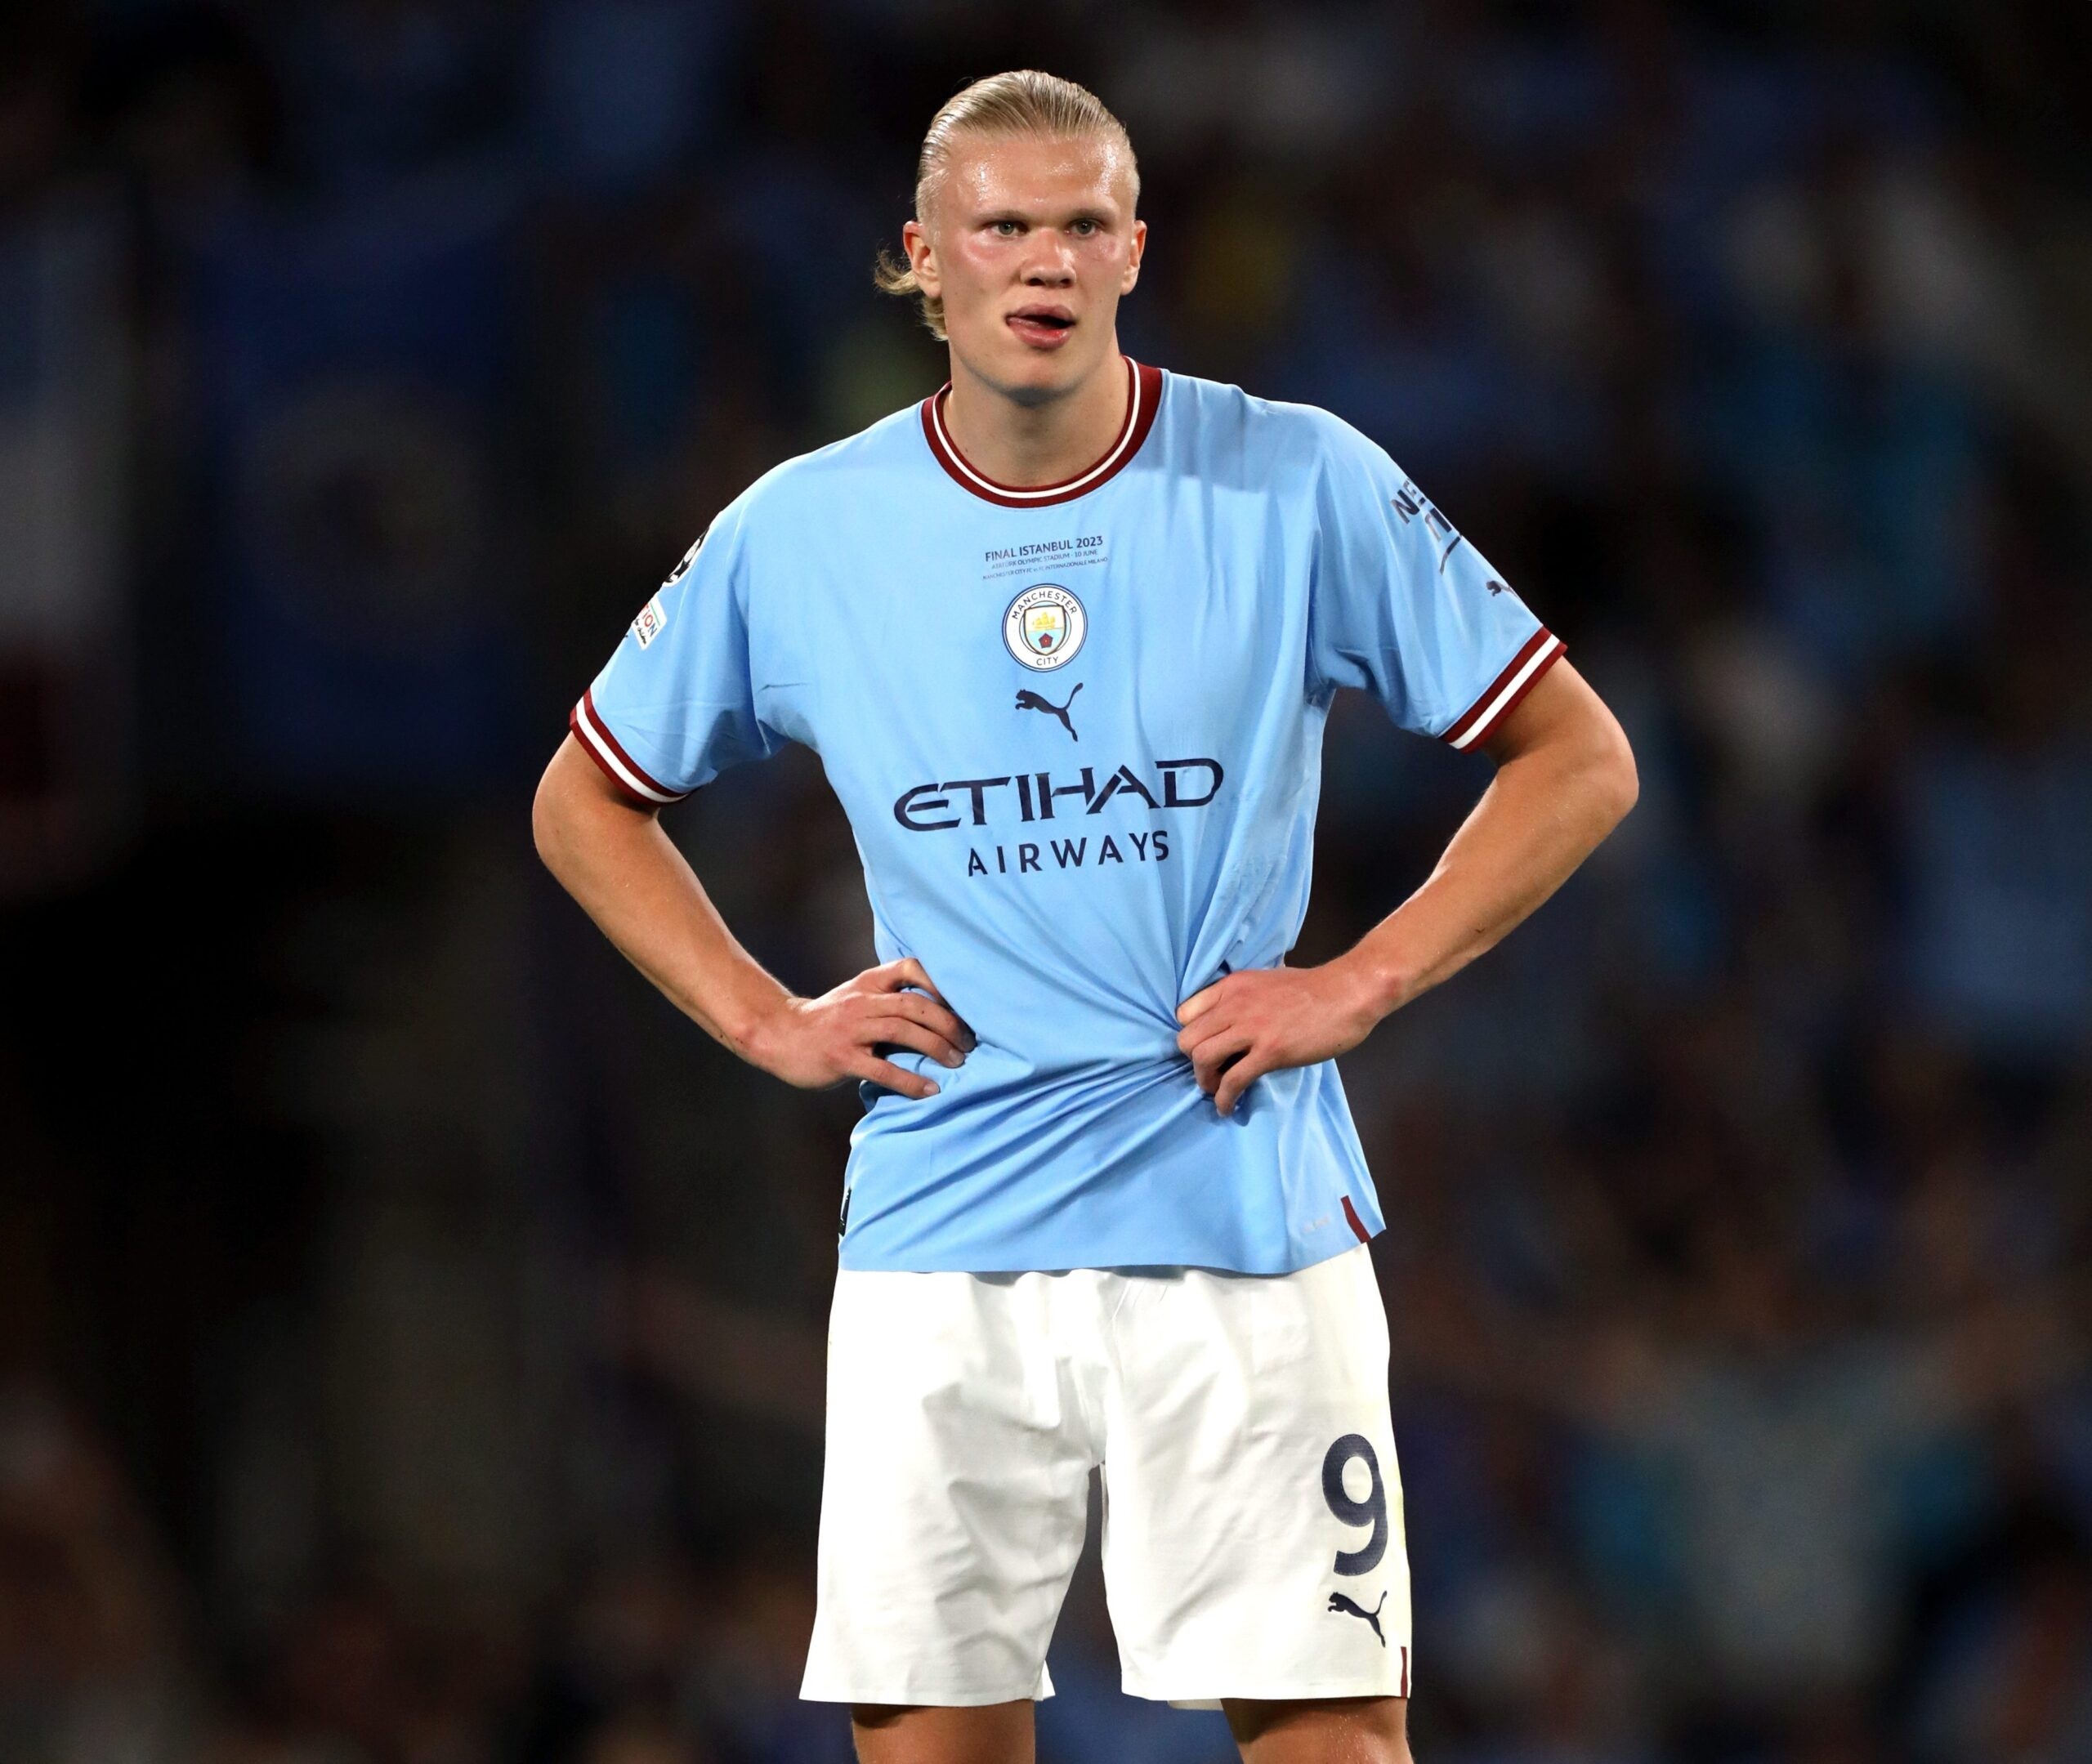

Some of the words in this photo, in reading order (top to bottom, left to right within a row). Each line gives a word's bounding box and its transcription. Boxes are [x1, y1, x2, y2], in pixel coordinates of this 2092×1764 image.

[985, 547, 1017, 562] FINAL
[1019, 539, 1073, 556] ISTANBUL
[1075, 536, 1103, 548] 2023
[1017, 556, 1043, 565] OLYMPIC
[1044, 553, 1070, 561] STADIUM
[1083, 549, 1098, 557] JUNE
[1012, 591, 1077, 619] MANCHESTER
[1036, 656, 1059, 666] CITY
[893, 757, 1224, 832] ETIHAD
[968, 830, 1169, 877] AIRWAYS
[1321, 1433, 1388, 1576] 9
